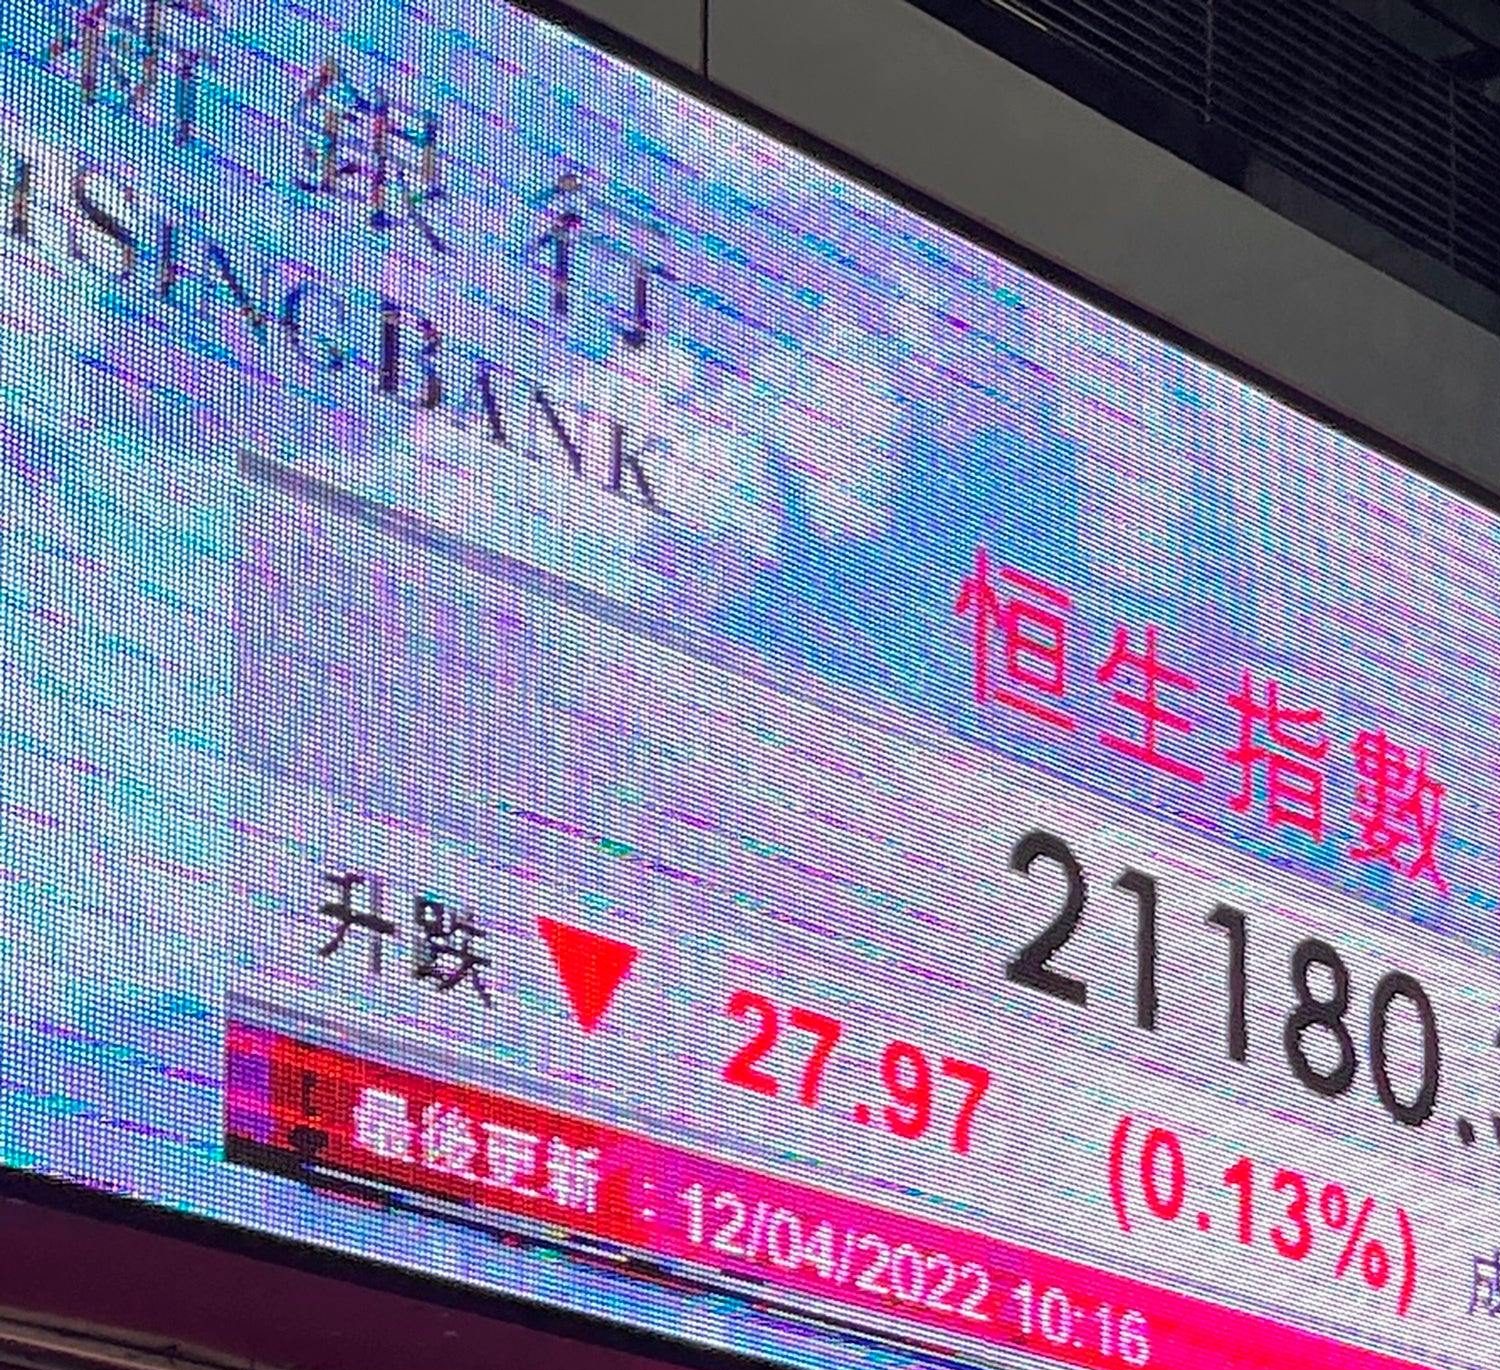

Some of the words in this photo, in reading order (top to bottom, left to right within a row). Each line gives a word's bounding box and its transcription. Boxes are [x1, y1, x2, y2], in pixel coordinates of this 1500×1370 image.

[956, 547, 1446, 892] 恒生指數
[317, 869, 491, 1004] 升跌
[722, 989, 991, 1155] 27.97
[1107, 1113, 1418, 1317] (0.13%)
[678, 1183, 989, 1323] 12/04/2022
[1009, 1278, 1151, 1369] 10:16
